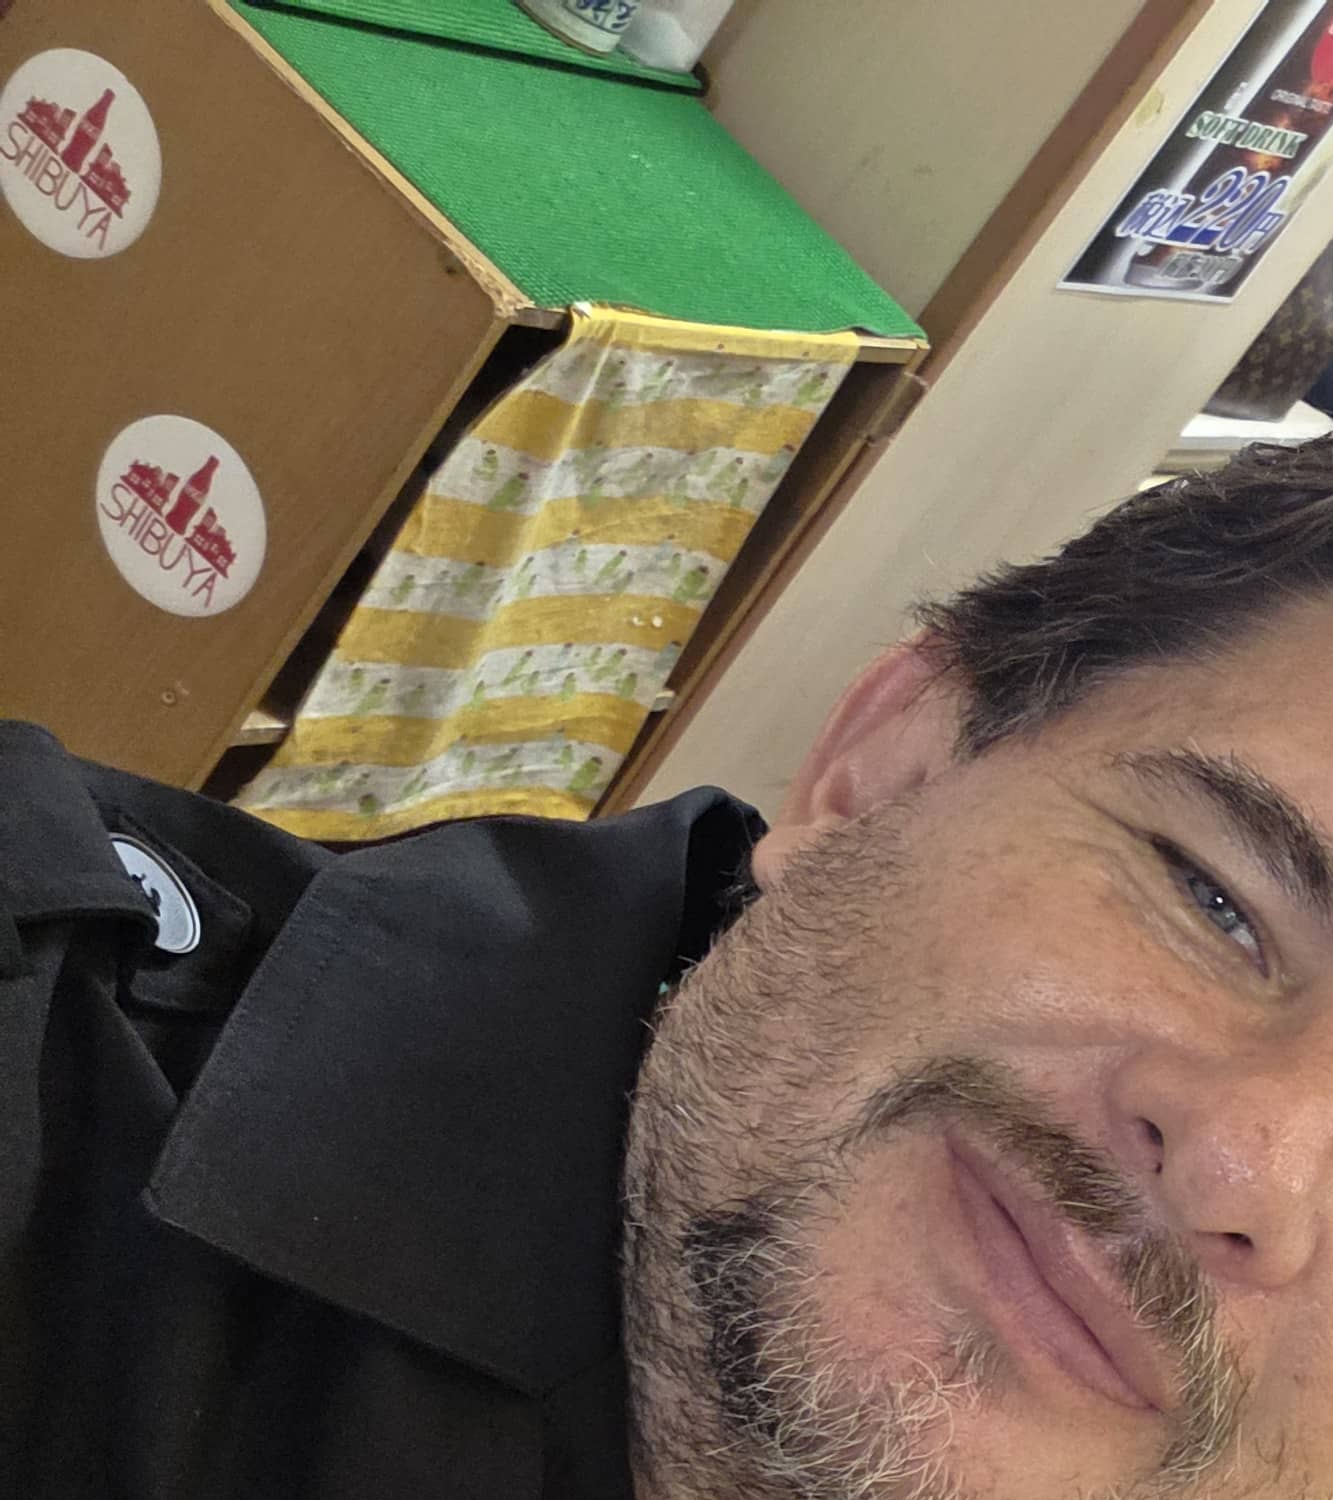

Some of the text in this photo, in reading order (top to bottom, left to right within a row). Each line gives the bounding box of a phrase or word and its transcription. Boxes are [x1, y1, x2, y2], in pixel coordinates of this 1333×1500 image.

[0, 121, 112, 251] SHIBUYA
[1186, 111, 1307, 158] SOFT DRINK
[101, 482, 217, 608] SHIBUYA
